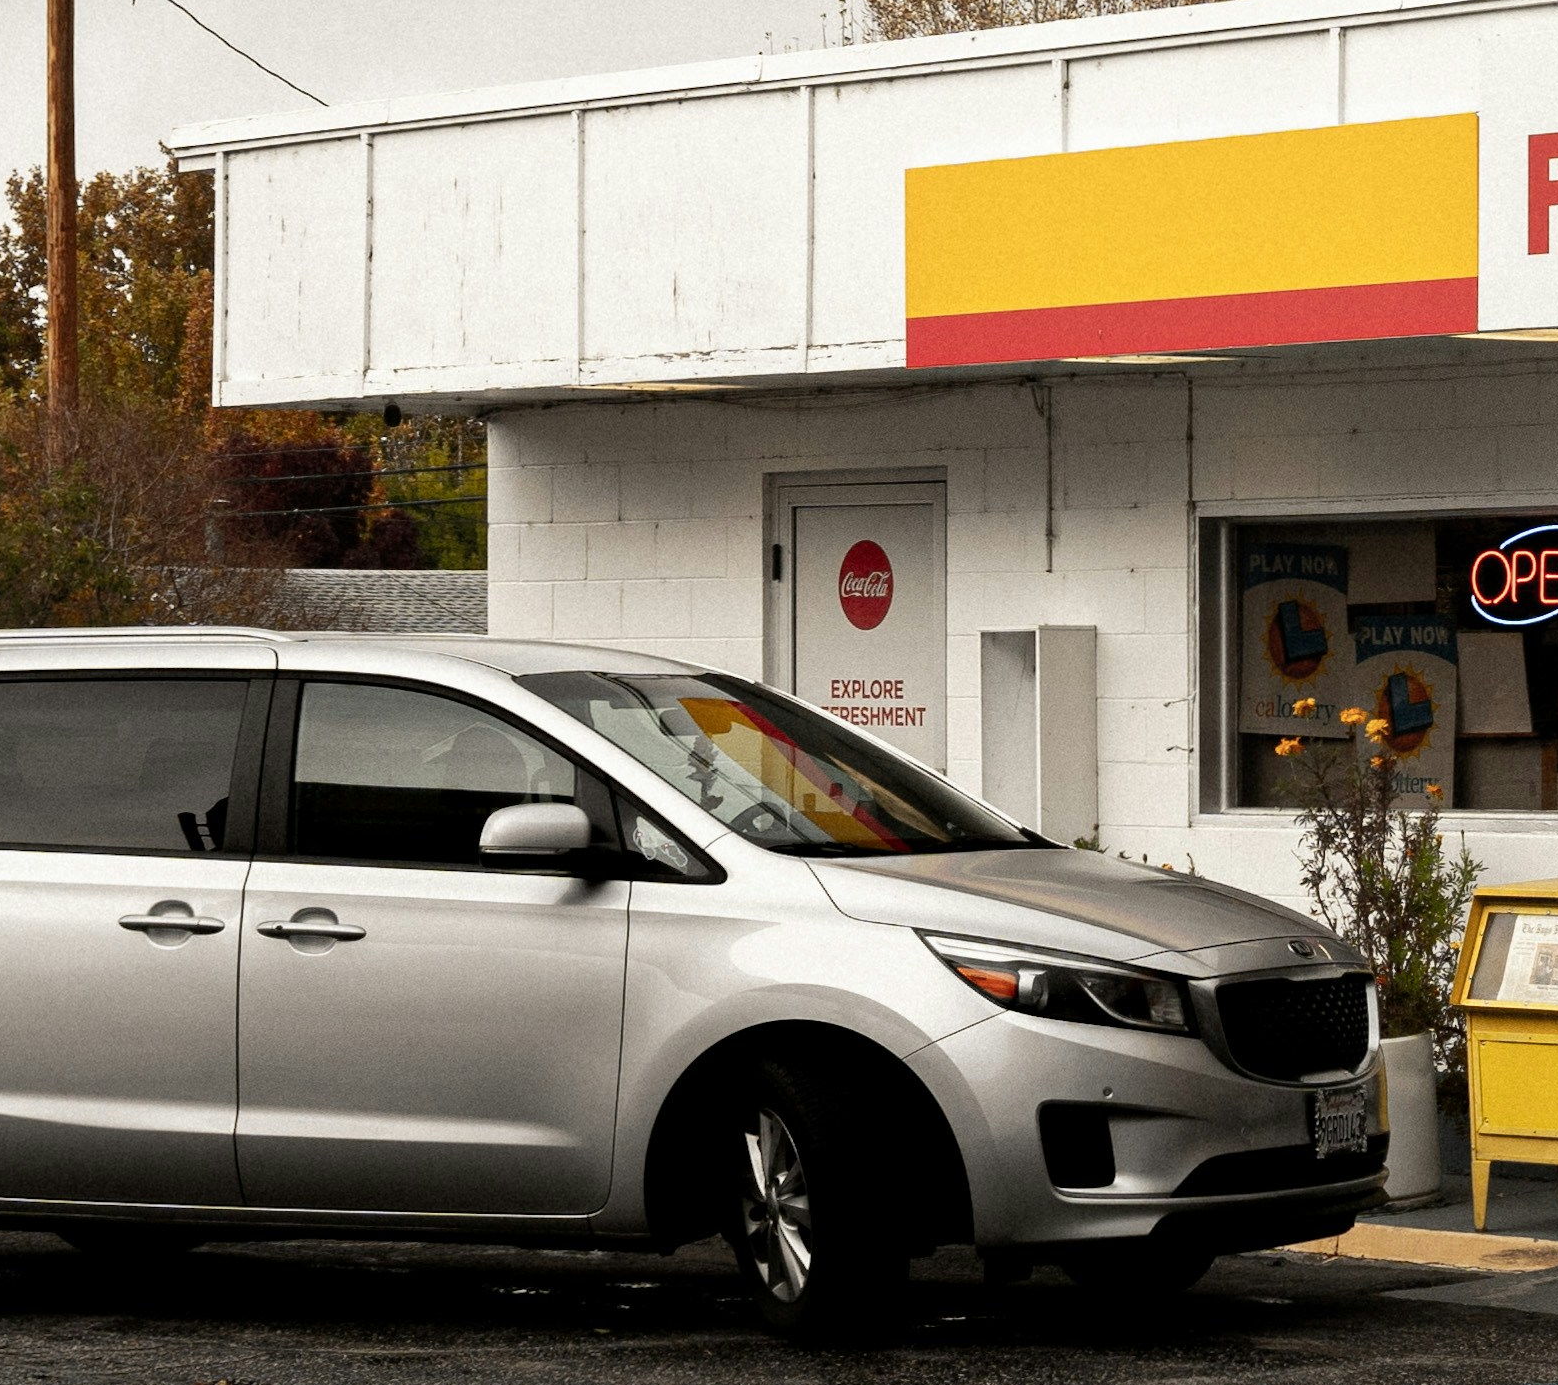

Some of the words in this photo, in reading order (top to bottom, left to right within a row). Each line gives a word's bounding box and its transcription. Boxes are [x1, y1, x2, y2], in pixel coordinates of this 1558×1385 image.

[1249, 554, 1292, 573] PLAY
[1361, 626, 1403, 646] PLAY
[1410, 625, 1449, 645] NOW
[831, 680, 904, 699] EXPLORE
